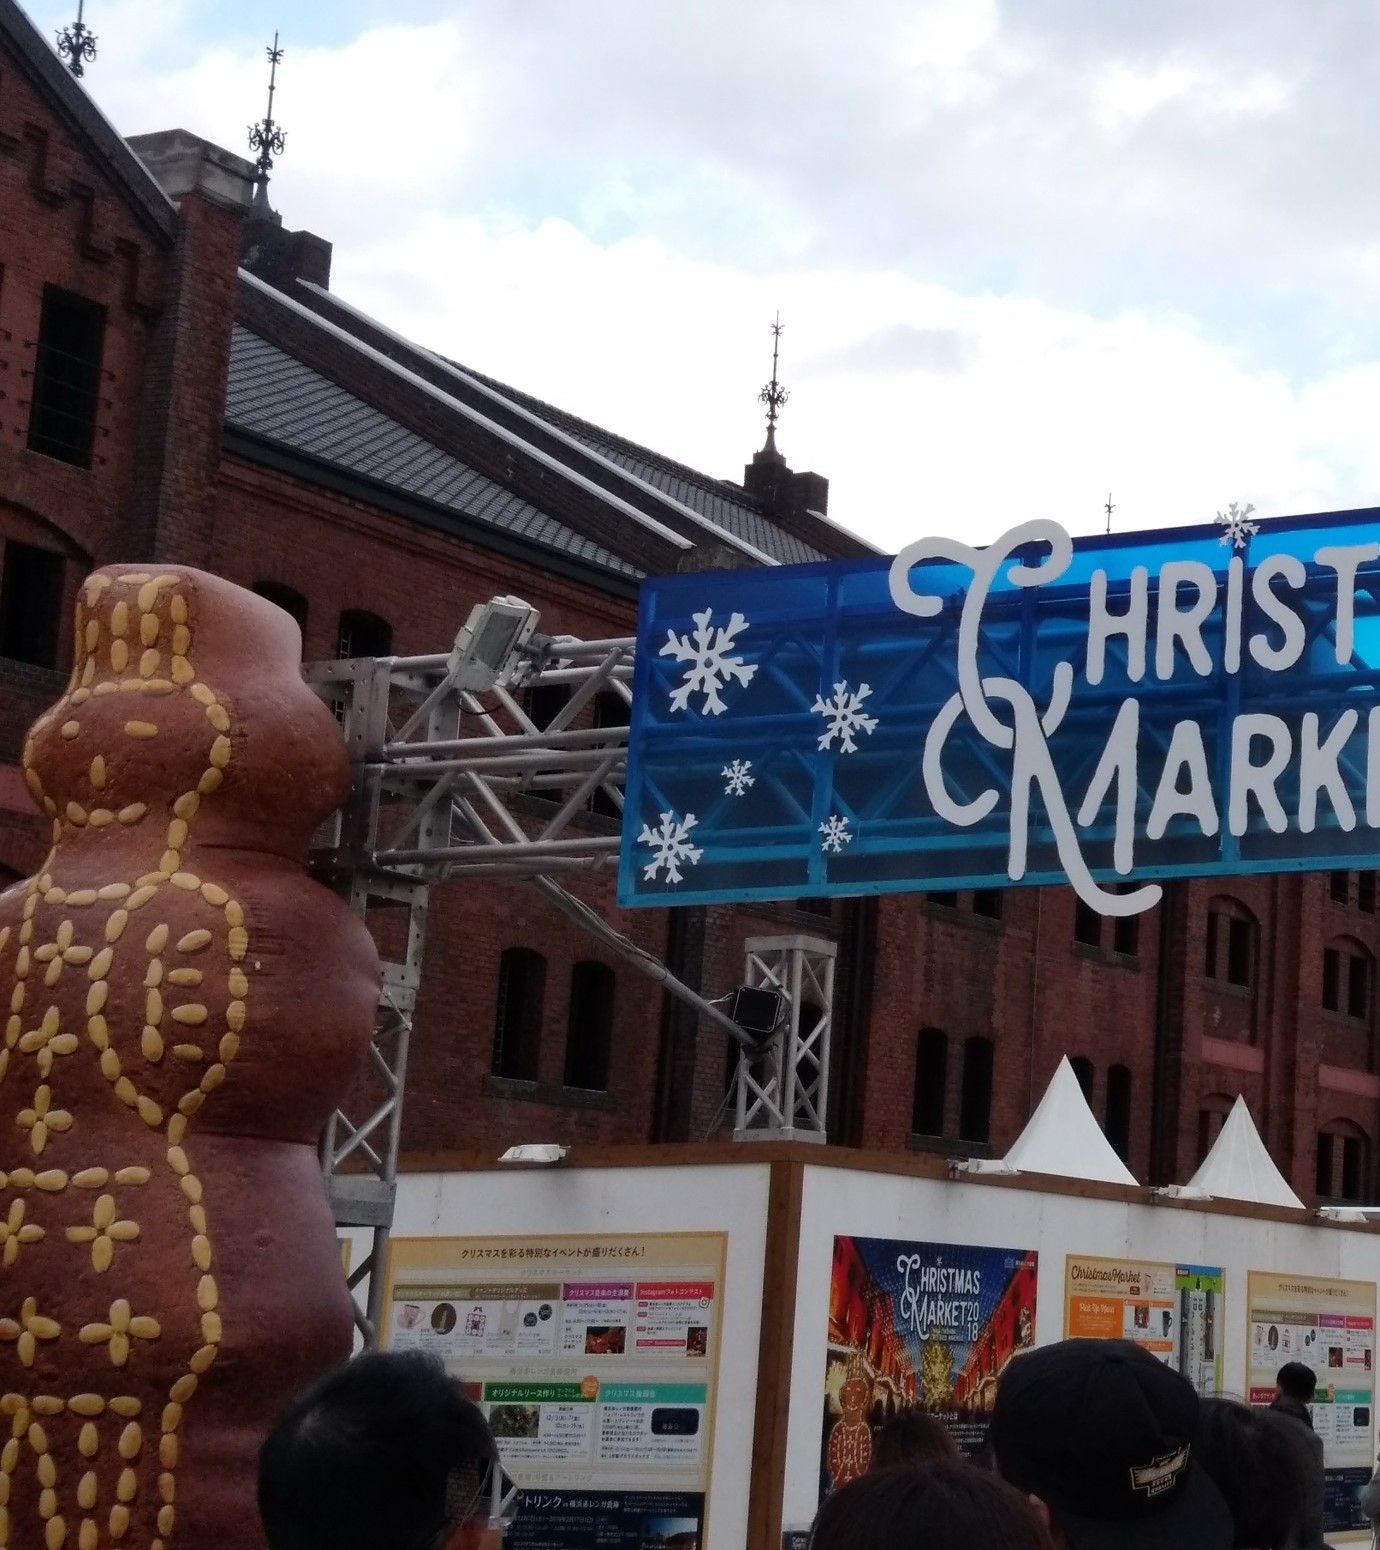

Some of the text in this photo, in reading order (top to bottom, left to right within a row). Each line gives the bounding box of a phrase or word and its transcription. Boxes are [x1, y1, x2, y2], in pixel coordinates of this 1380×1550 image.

[896, 1253, 981, 1303] CHRISTMAS
[900, 1287, 980, 1341] MARKET 20
[967, 1325, 979, 1342] 18
[491, 1388, 556, 1399] オリジナルリース作り
